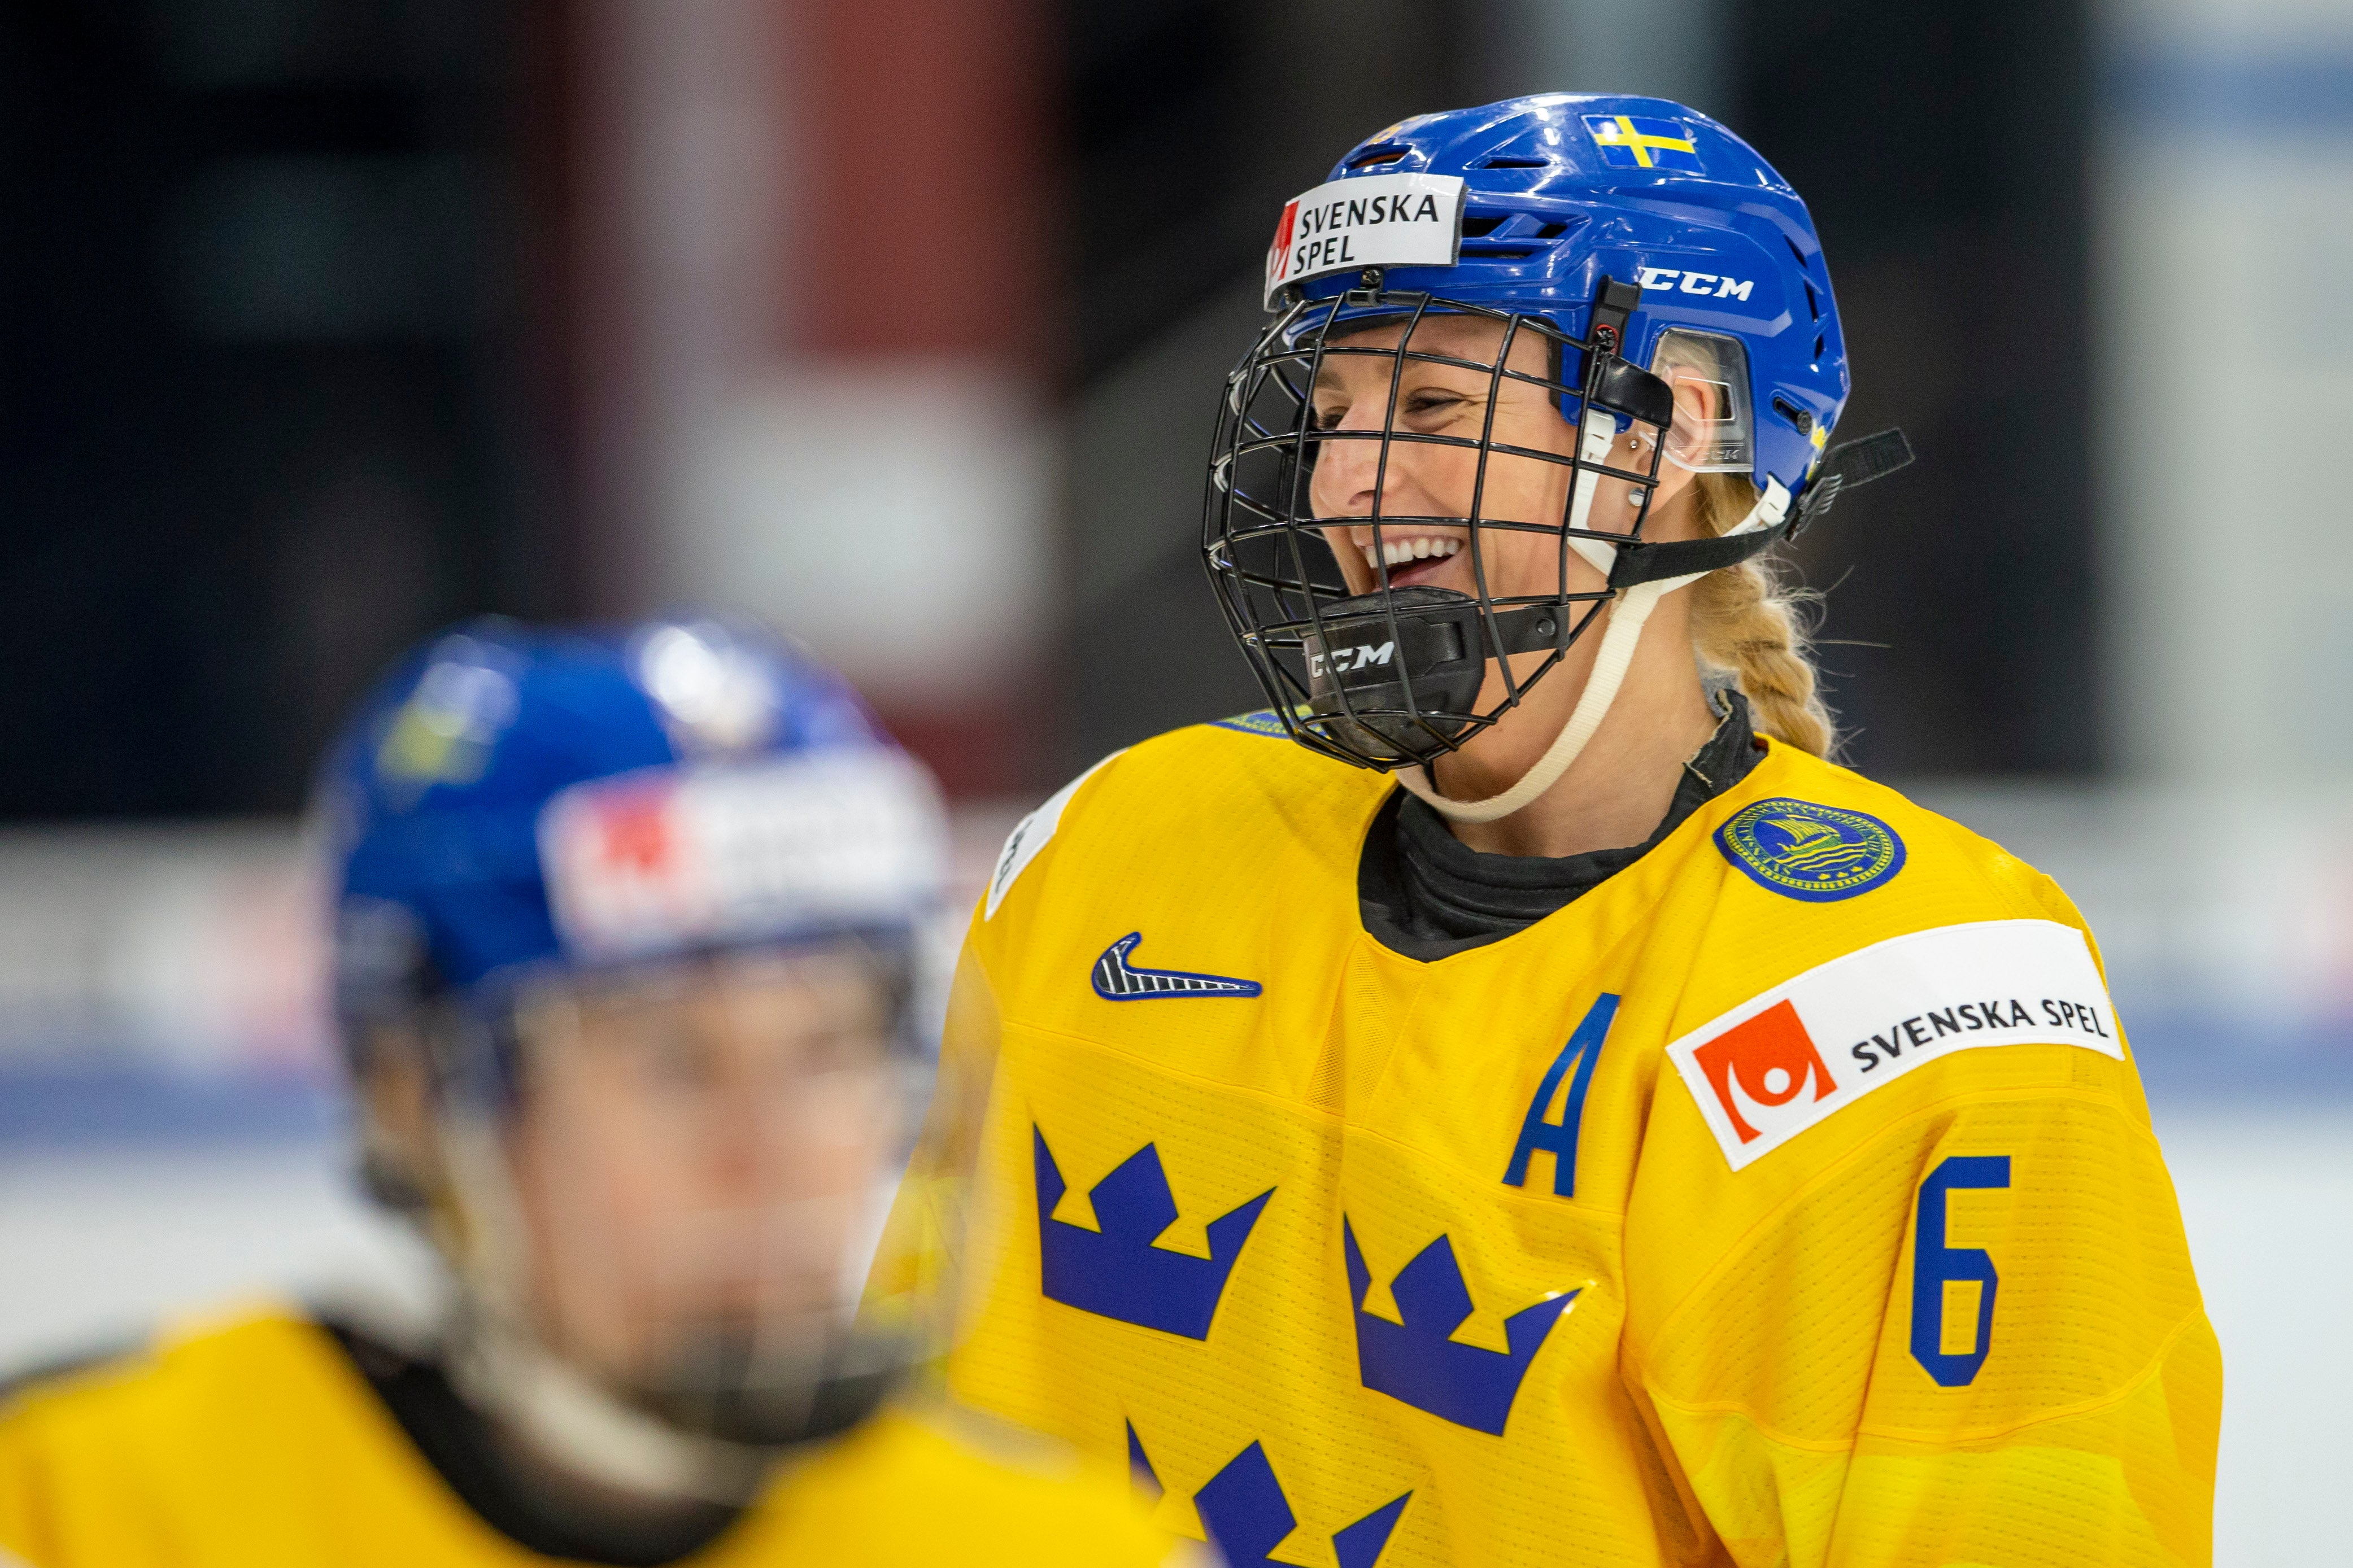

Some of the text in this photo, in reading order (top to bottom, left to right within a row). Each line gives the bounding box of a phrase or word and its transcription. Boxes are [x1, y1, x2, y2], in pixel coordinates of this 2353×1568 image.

[1300, 194, 1439, 241] SVENSKA
[1293, 235, 1355, 275] SPEL
[1638, 267, 1754, 302] CCM
[1851, 999, 2110, 1073] SVENSKA SPEL
[1501, 992, 1622, 1198] A
[1910, 1156, 2011, 1387] 6
